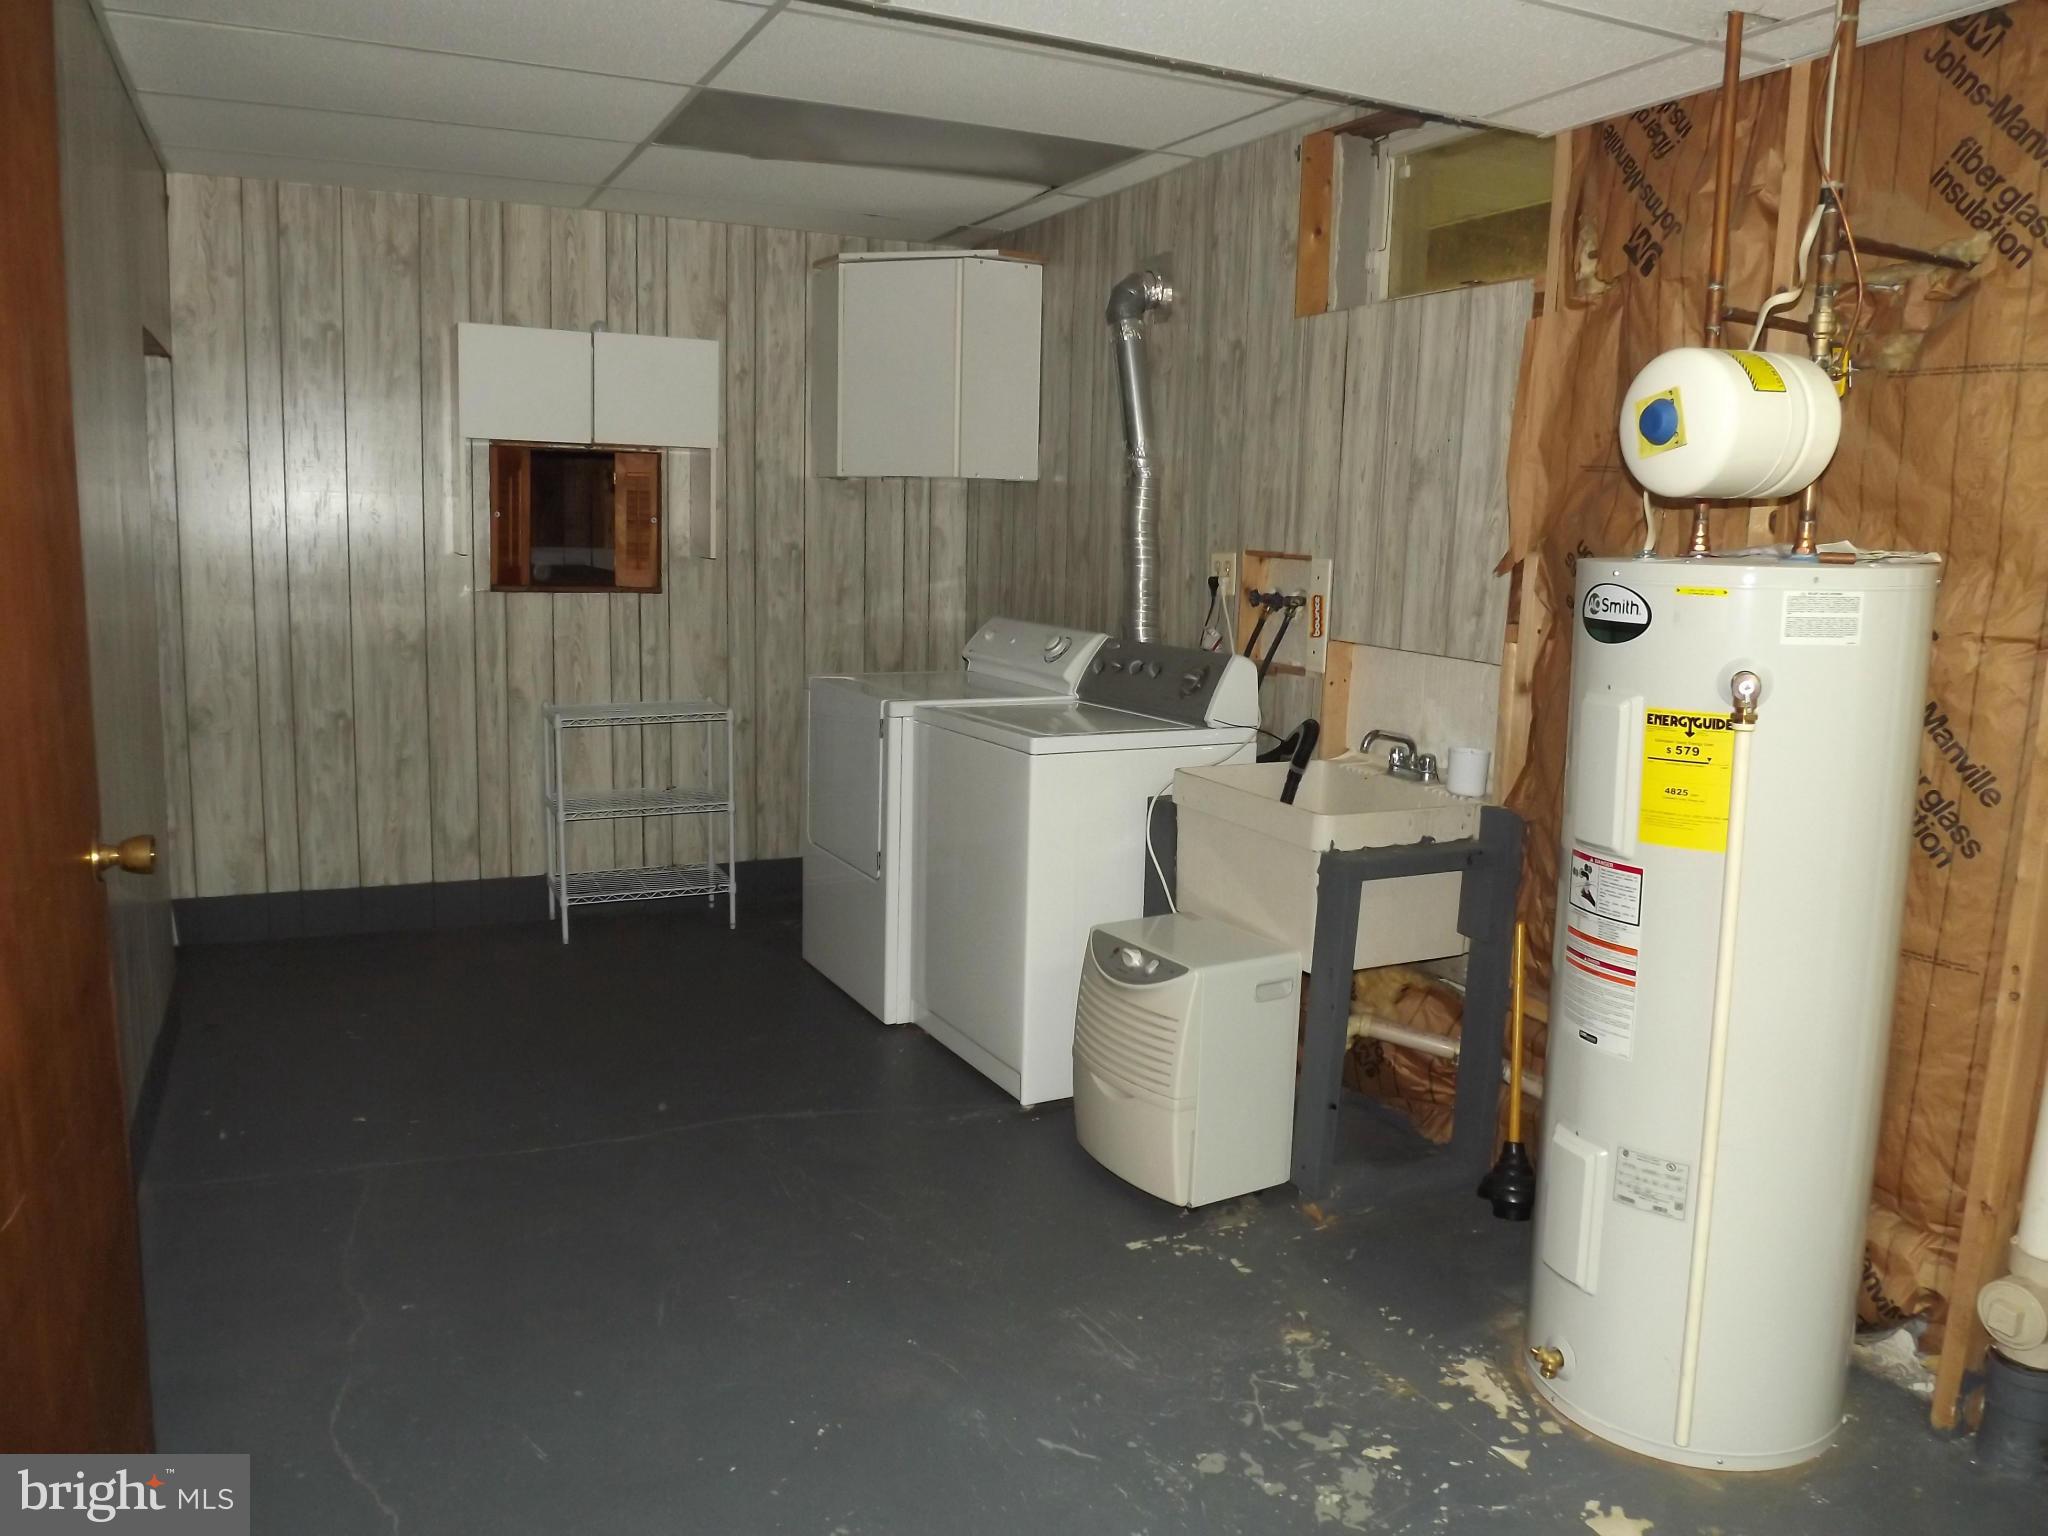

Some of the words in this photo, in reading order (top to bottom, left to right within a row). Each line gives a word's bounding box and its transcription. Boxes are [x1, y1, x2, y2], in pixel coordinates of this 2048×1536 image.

[1923, 40, 2048, 168] Johns-Manv
[1603, 123, 1683, 241] Johns-Manville
[1930, 160, 2033, 270] insulation
[1951, 136, 2006, 193] fiber
[1992, 190, 2048, 249] glas
[1602, 597, 1640, 616] Smith
[1664, 787, 1689, 797] 4825
[1675, 745, 1700, 757] 579
[1919, 789, 1982, 860] glass
